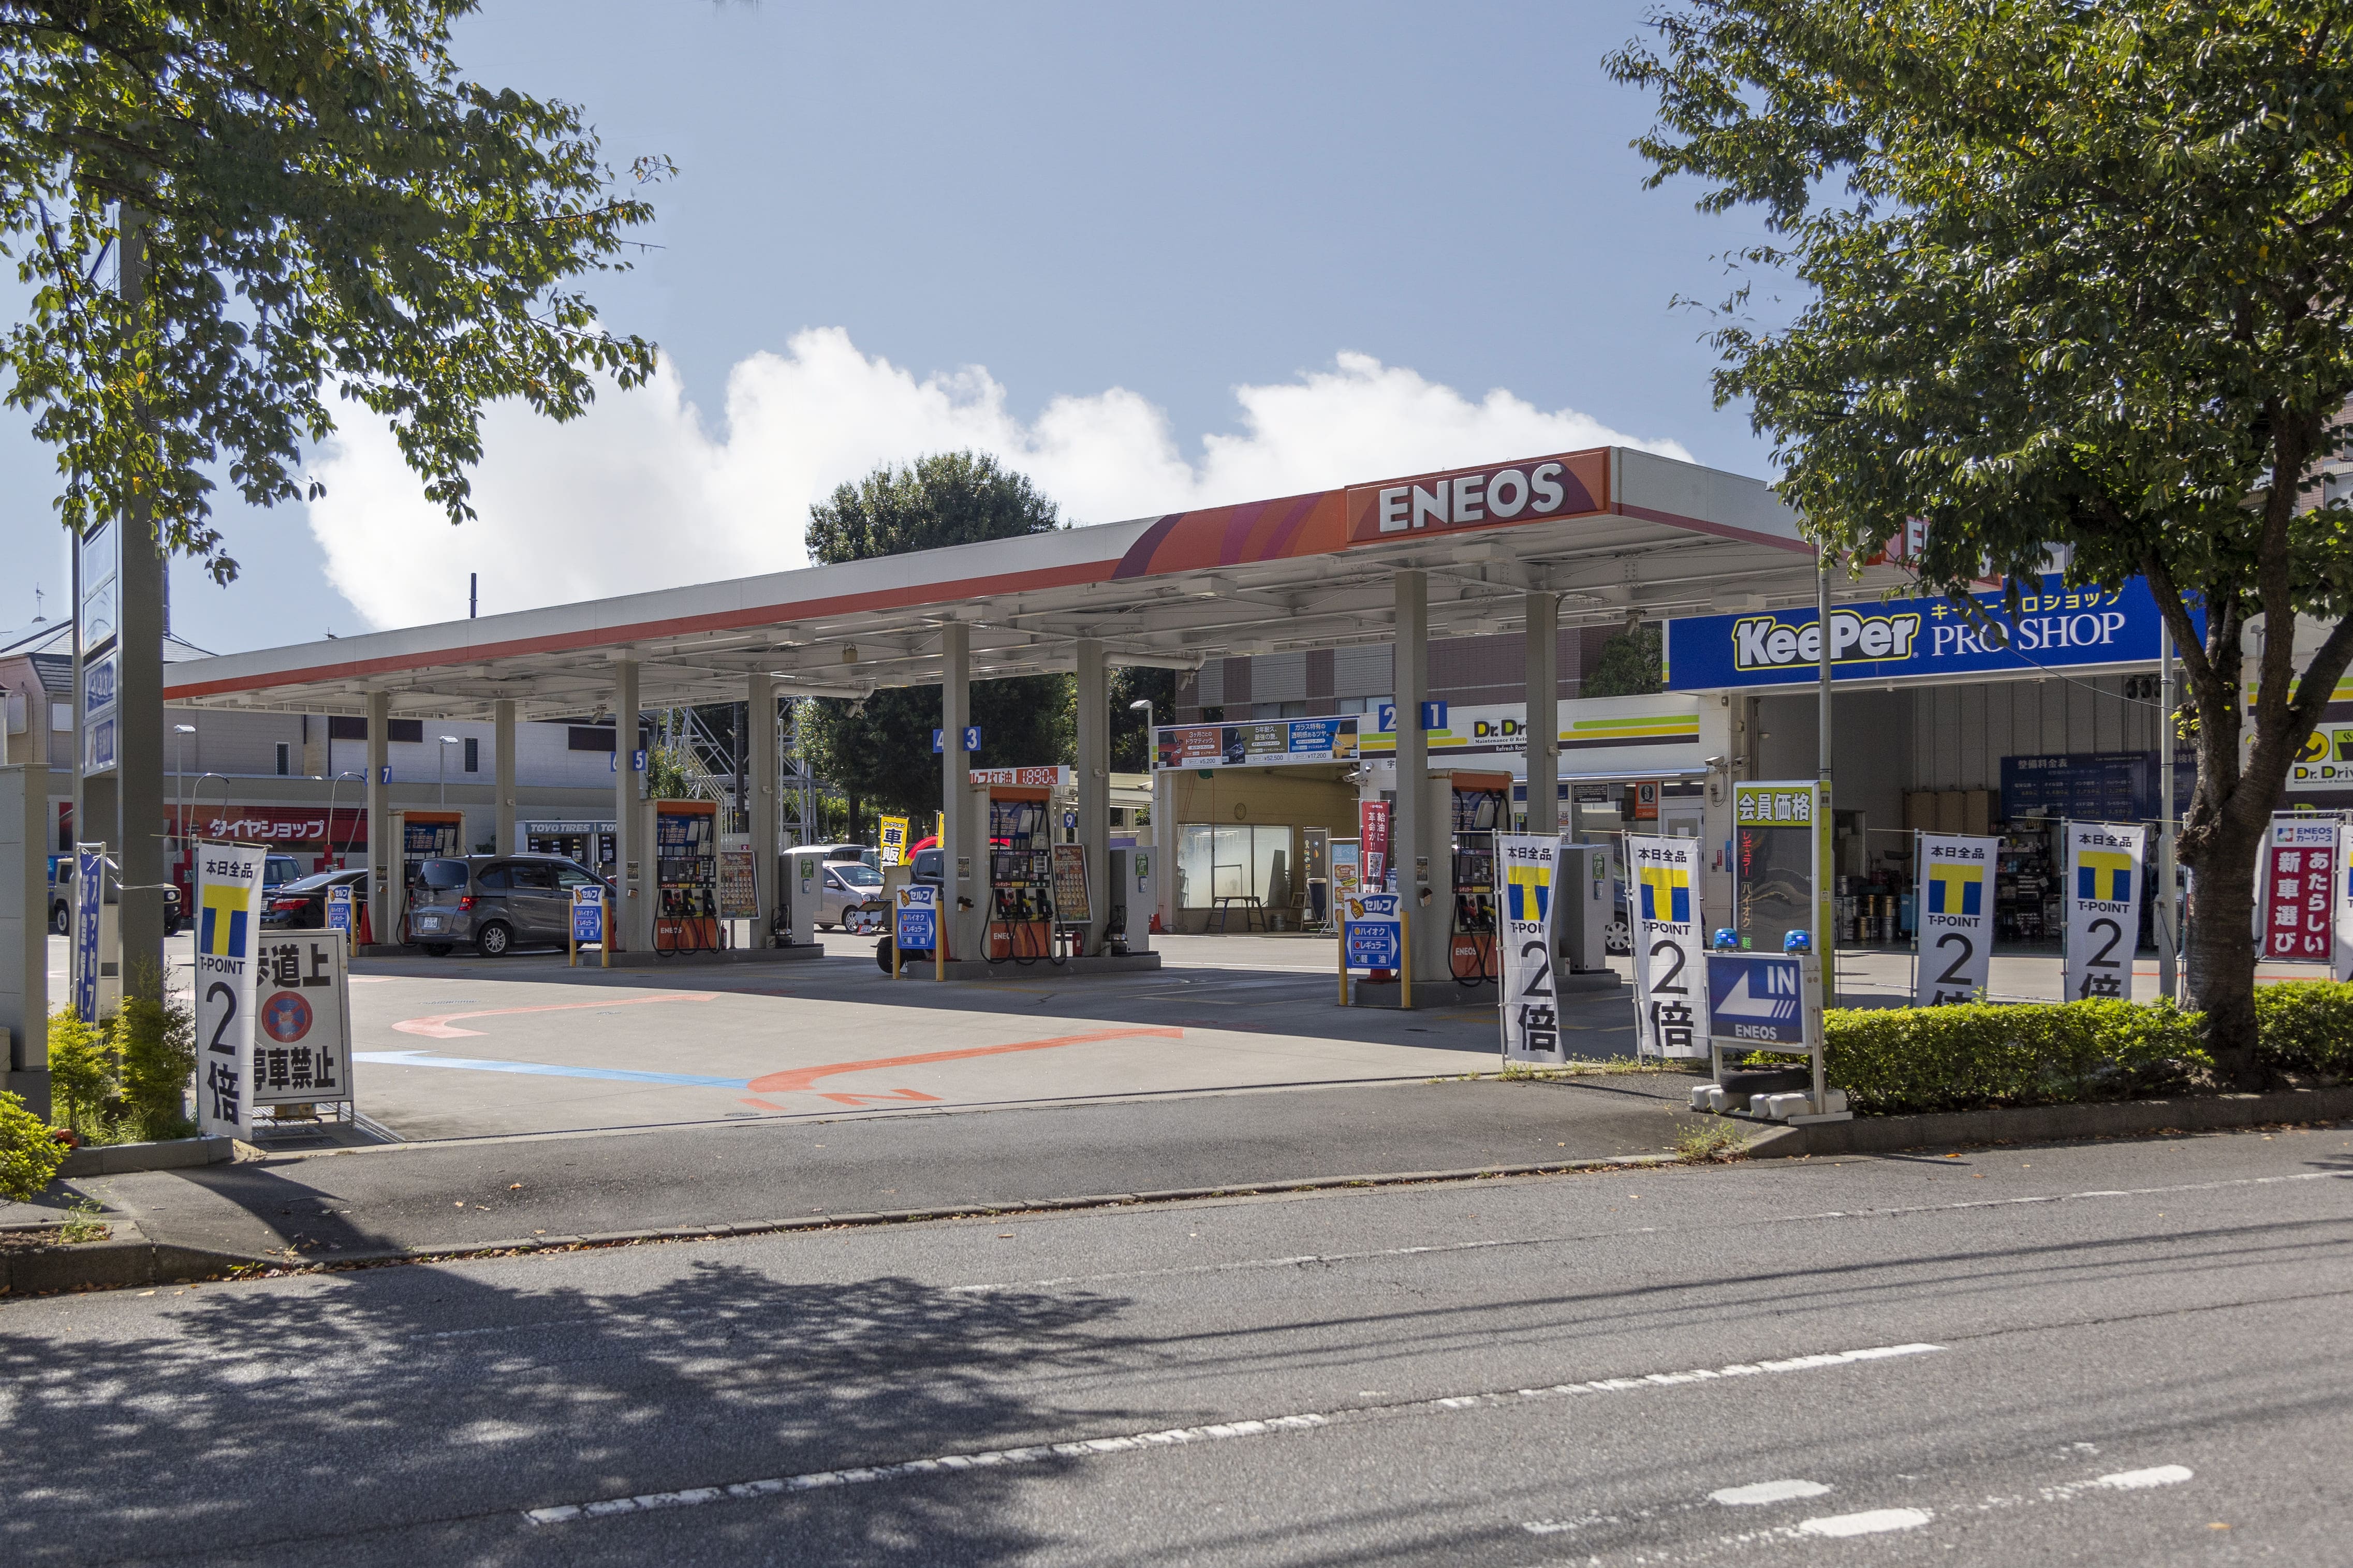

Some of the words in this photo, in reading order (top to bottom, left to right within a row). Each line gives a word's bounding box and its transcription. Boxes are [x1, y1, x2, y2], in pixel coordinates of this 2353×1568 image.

[1379, 463, 1566, 532] ENEOS
[1737, 615, 1916, 665] KeePer
[1931, 622, 2008, 657] PRO
[2019, 612, 2125, 651] SHOP
[1384, 707, 1396, 730] 2
[1431, 704, 1438, 726] 1
[1474, 720, 1498, 737] Dr.
[967, 729, 977, 748] 3
[635, 751, 643, 769] 5
[384, 768, 390, 783] 7
[2294, 766, 2317, 779] Dr.
[1739, 793, 1810, 821] 会員価格
[210, 819, 325, 838] タイヤショップ
[1065, 815, 1073, 827] 9
[1377, 812, 1386, 841] 給油に
[2079, 833, 2132, 848] 本日全品
[1507, 846, 1552, 862] 本日全品
[1638, 848, 1687, 863] 本日全品
[1743, 831, 1751, 876] レギュラー
[1931, 846, 1985, 860] 本日全品
[206, 859, 254, 879] 本日全品
[582, 890, 597, 898] セルフ
[910, 891, 930, 900] セルフ
[2275, 852, 2301, 952] 新車選び
[2304, 852, 2329, 952] あたらしい
[1364, 899, 1391, 911] セルフ
[1742, 883, 1751, 928] ハイオク
[2077, 901, 2130, 914] T-POINT
[1641, 921, 1691, 935] T-POINT
[1928, 915, 1981, 928] T-POINT
[1360, 927, 1385, 936] ハイオク
[1360, 941, 1386, 950] レギュラー
[200, 955, 246, 975] T-POINT
[1767, 966, 1796, 995] IN
[1735, 1024, 1777, 1040] ENEOS
